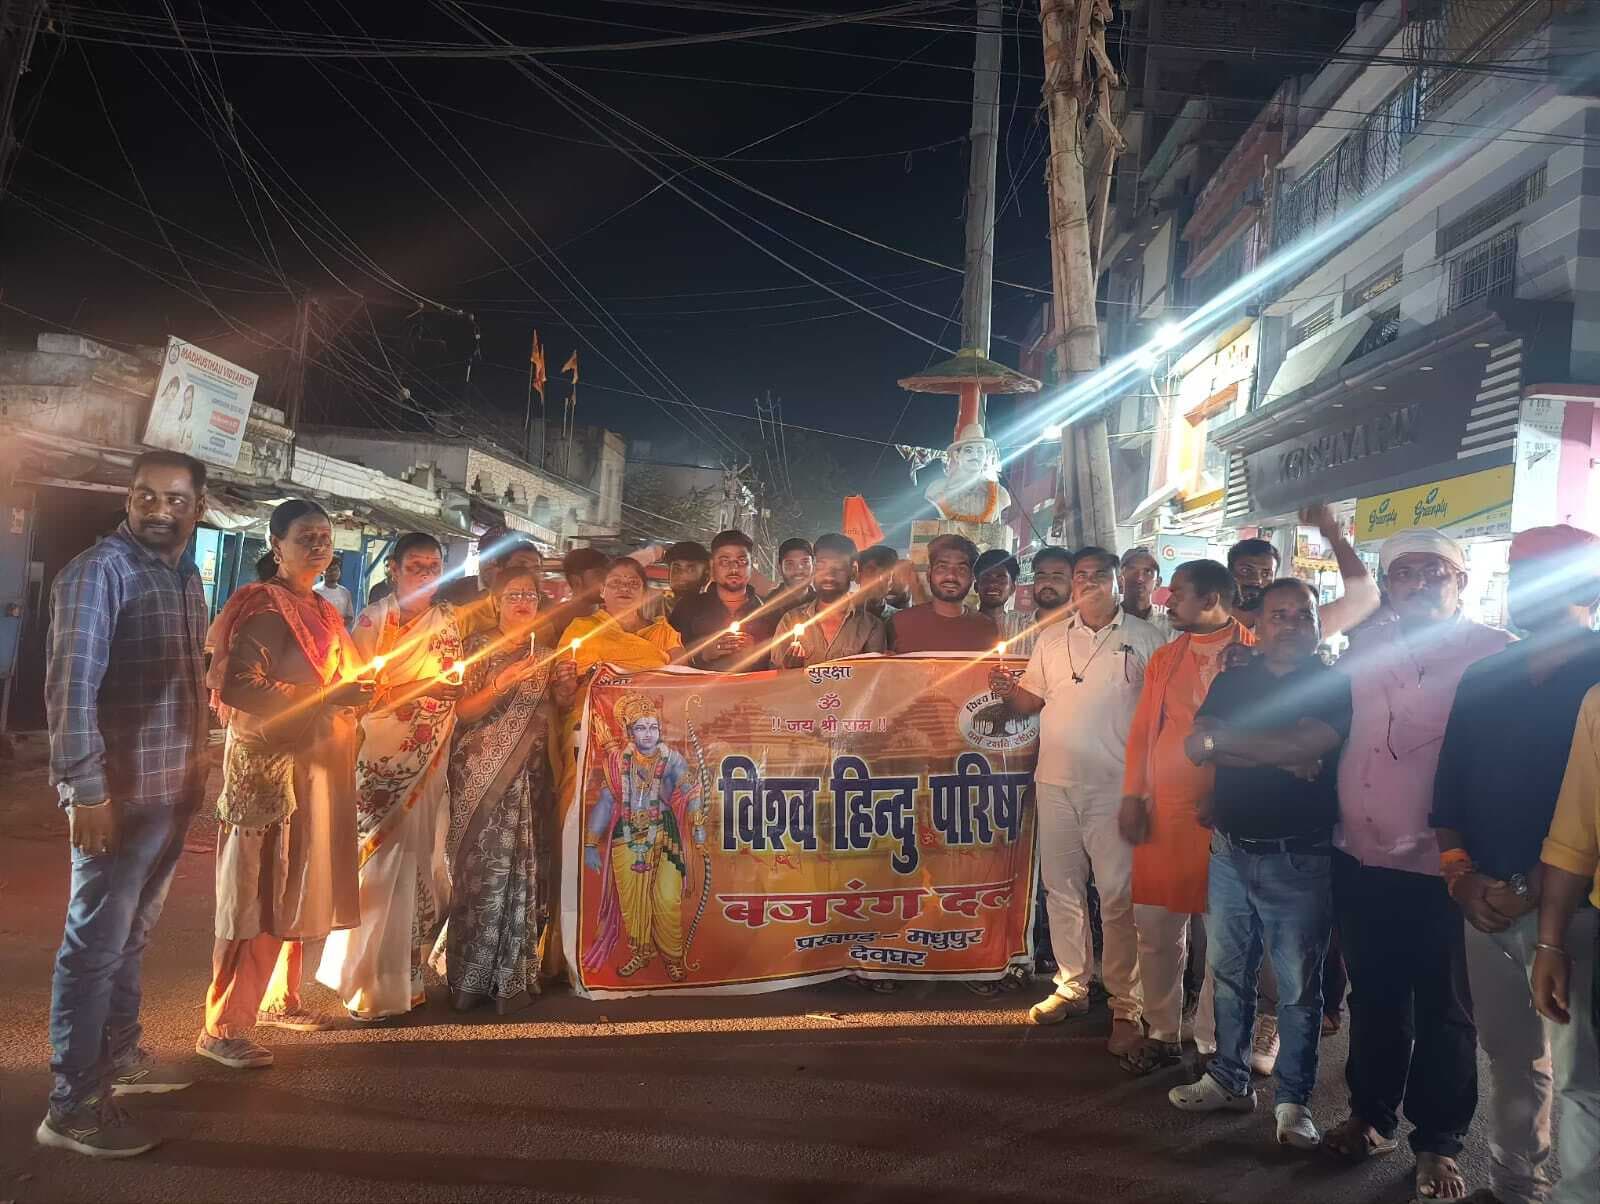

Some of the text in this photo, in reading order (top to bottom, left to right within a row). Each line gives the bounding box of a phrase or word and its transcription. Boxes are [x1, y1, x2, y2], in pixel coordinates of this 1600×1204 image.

[807, 665, 852, 684] सुरक्षा
[786, 719, 814, 732] जय
[821, 715, 838, 733] श्री
[841, 719, 872, 733] राम
[718, 756, 819, 851] विश्व
[928, 753, 1035, 844] परिष
[716, 880, 933, 928] बजरंग
[906, 929, 985, 950] मधुपुर
[849, 945, 927, 966] देवघर
